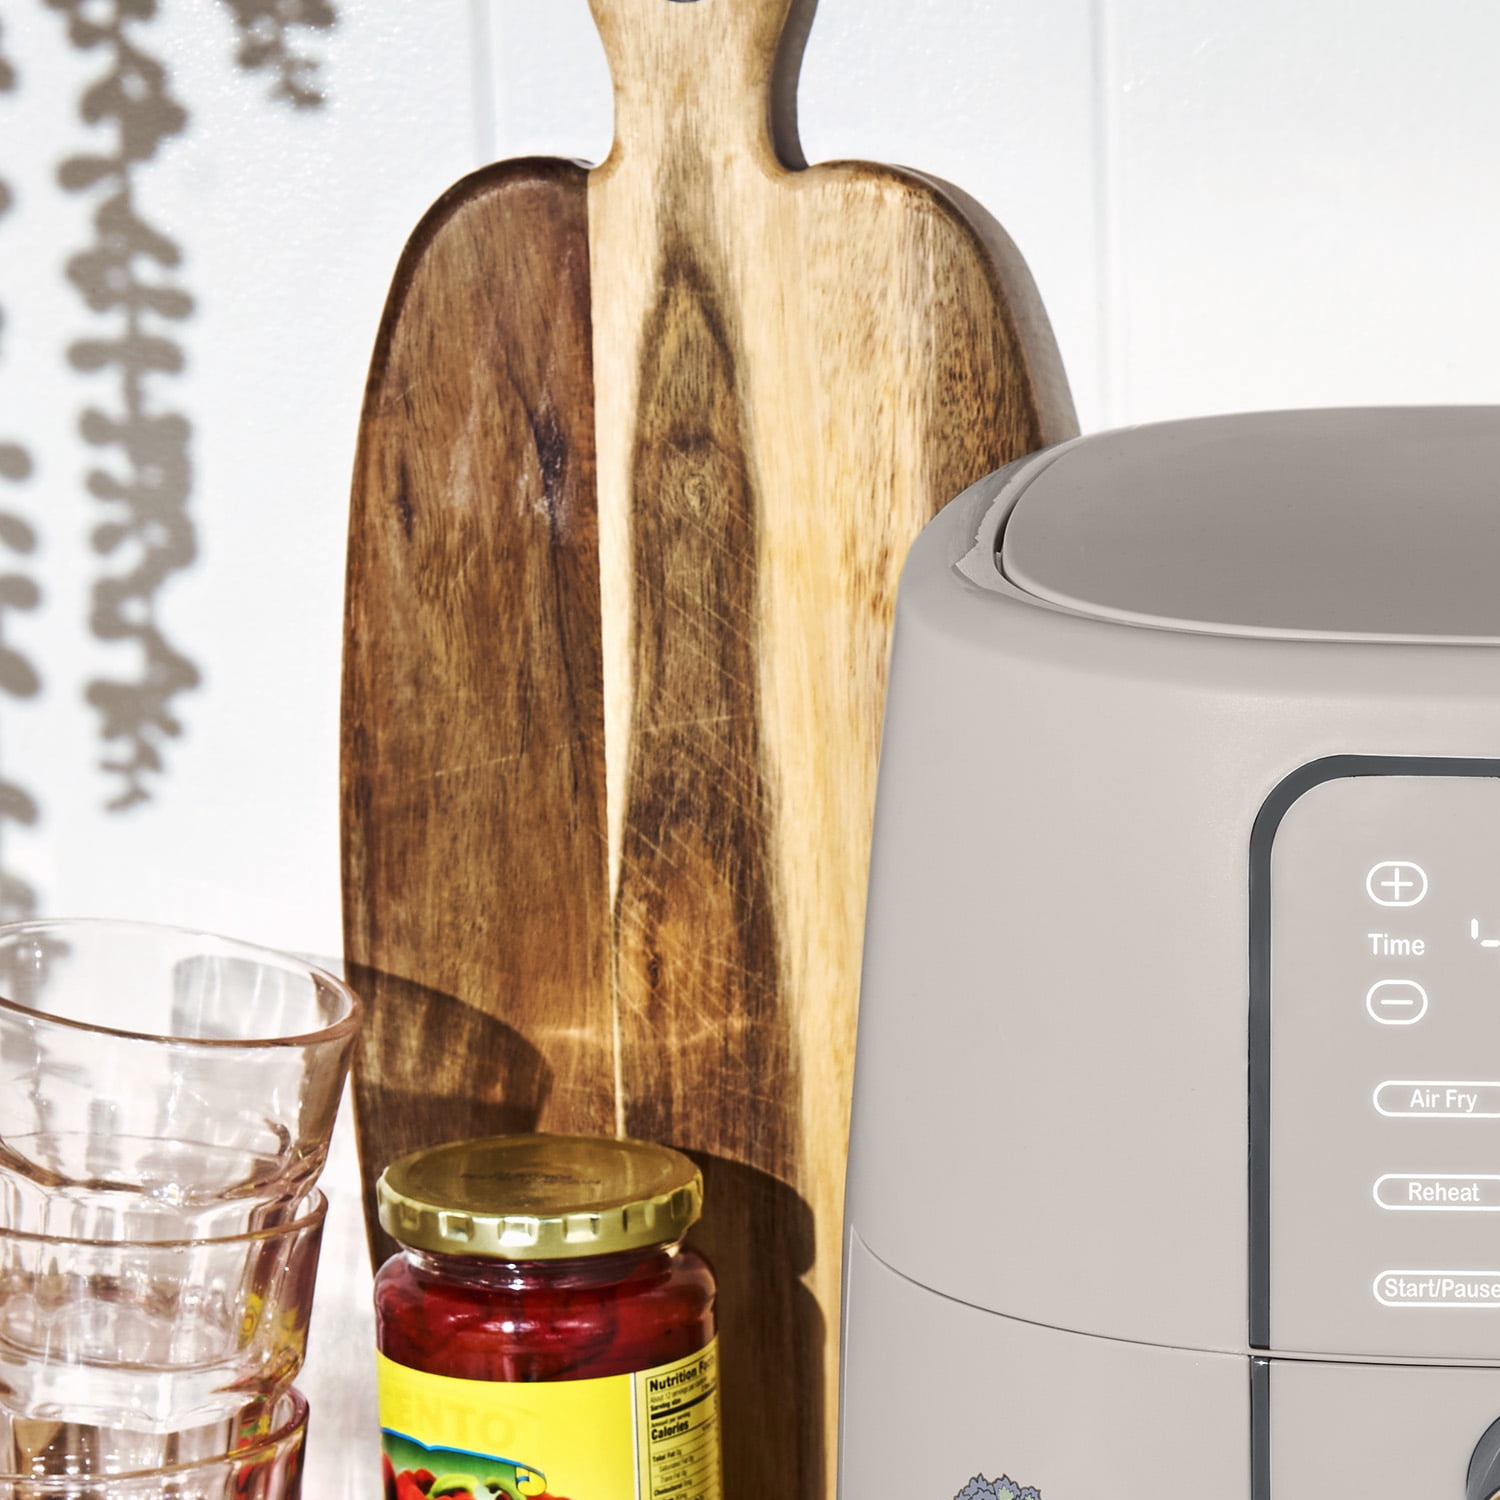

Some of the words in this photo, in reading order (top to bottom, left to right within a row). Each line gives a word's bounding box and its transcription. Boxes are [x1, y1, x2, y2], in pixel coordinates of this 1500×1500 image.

[1367, 933, 1425, 956] Time
[1409, 1088, 1440, 1109] Air
[1445, 1089, 1478, 1113] Fry
[1407, 1182, 1481, 1203] Reheat
[650, 1368, 698, 1392] Nutrition
[651, 1421, 689, 1440] Calories
